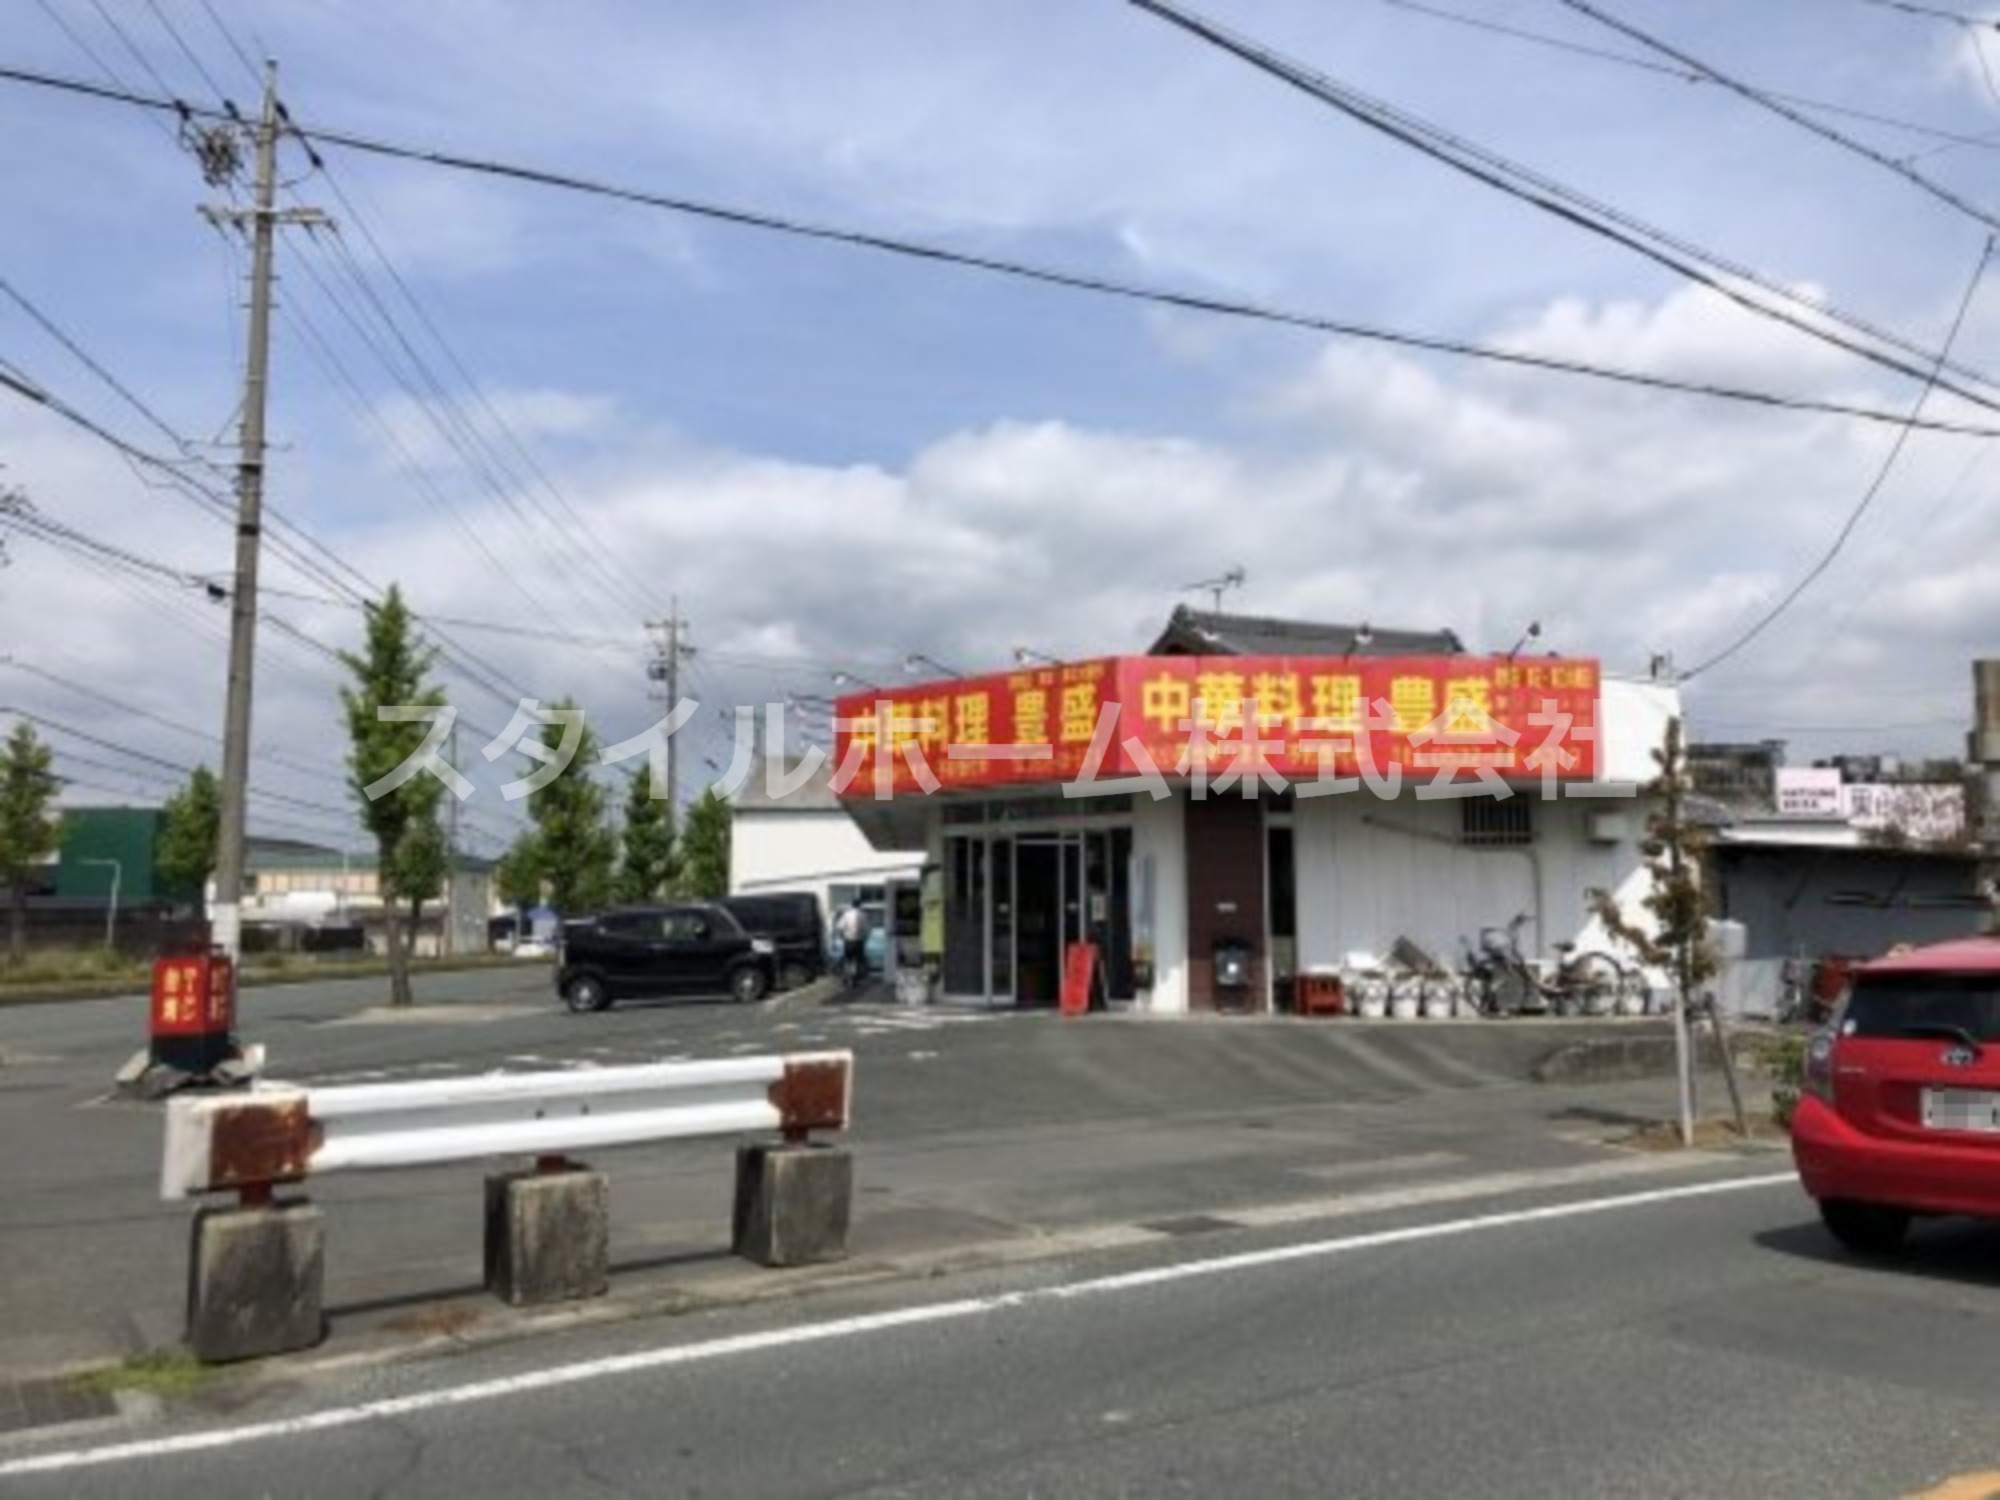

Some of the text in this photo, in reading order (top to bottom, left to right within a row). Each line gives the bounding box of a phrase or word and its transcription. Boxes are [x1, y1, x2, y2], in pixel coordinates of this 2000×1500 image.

[1142, 670, 1362, 735] 中華料理
[1388, 674, 1494, 737] 豊盛
